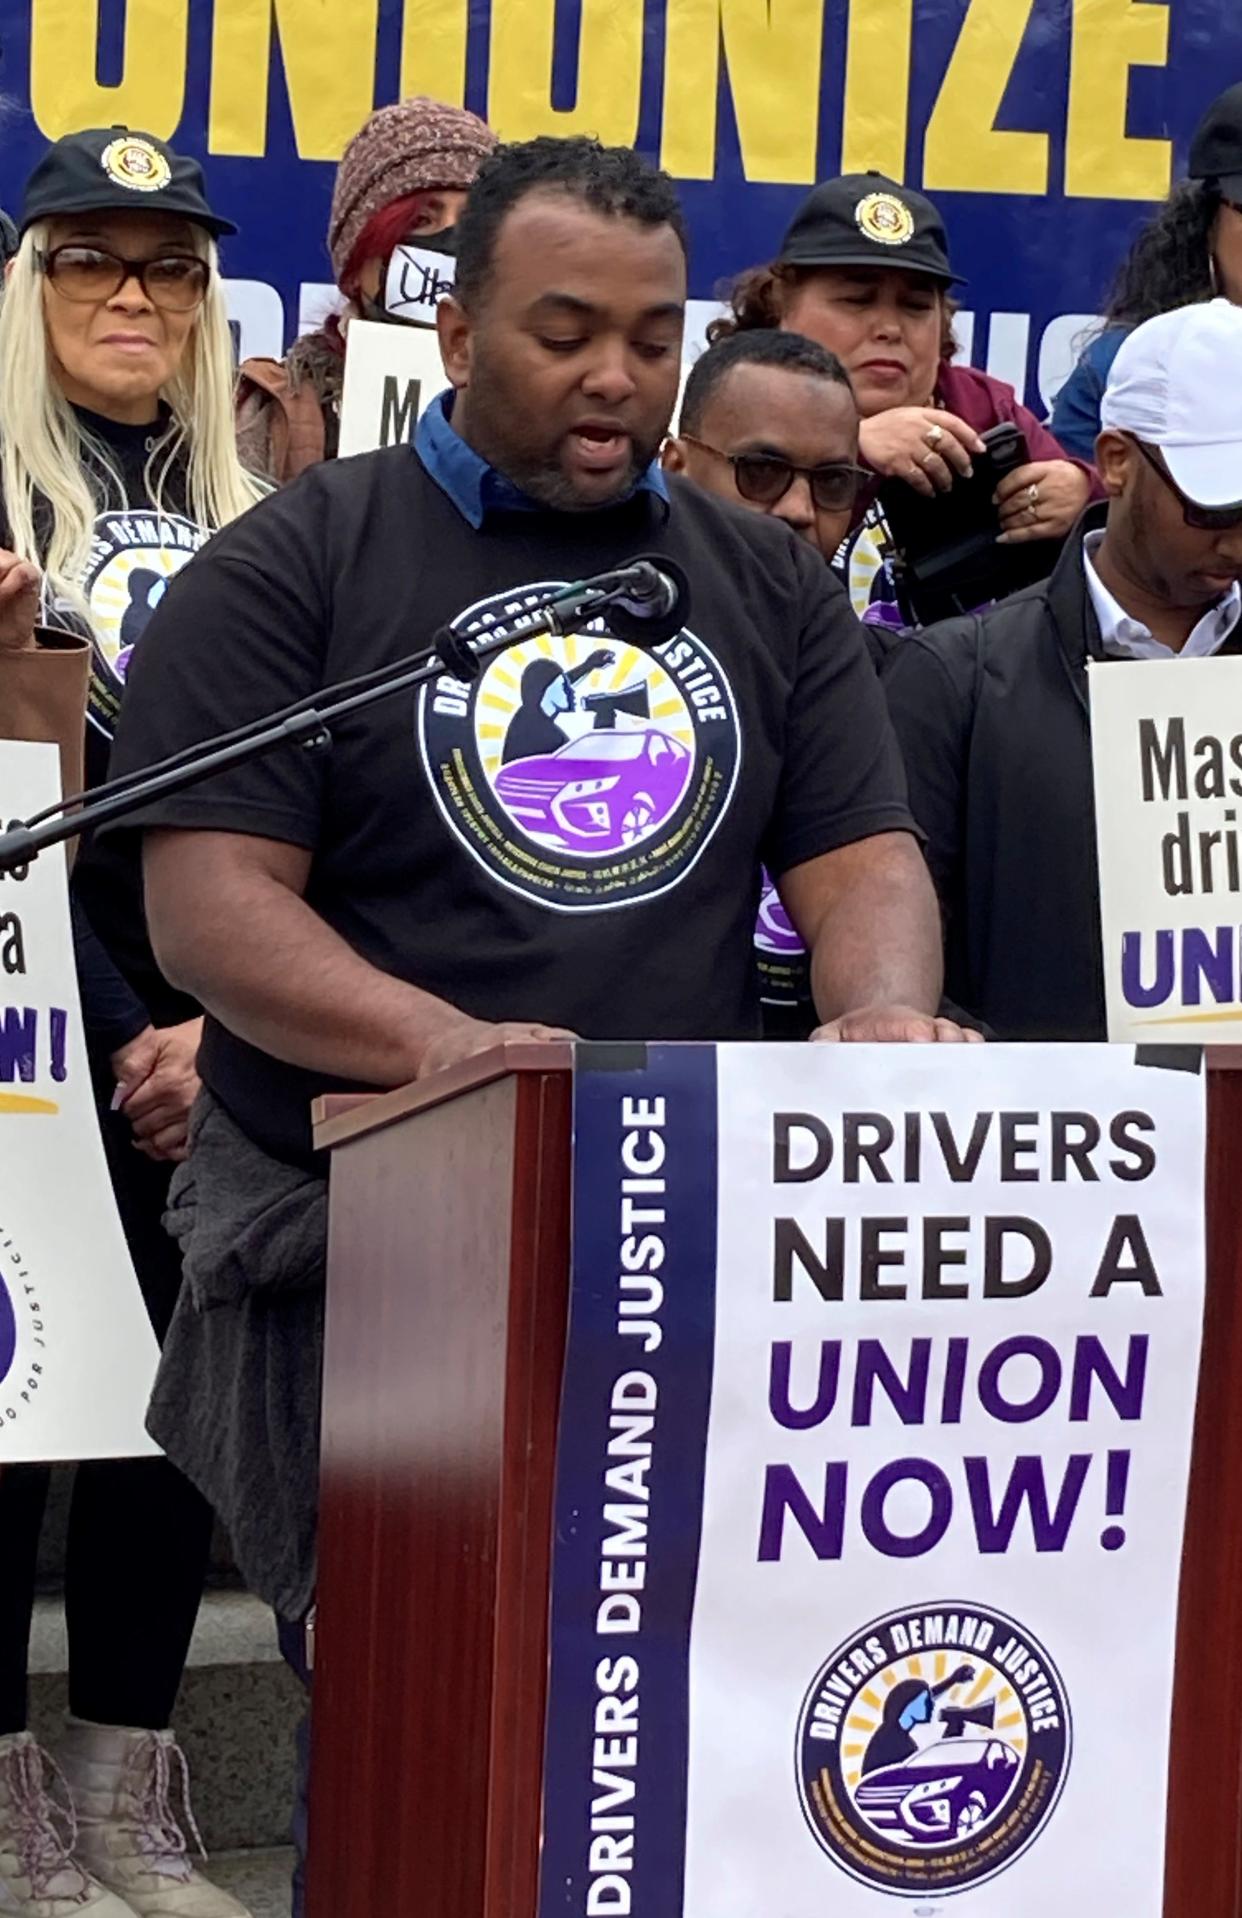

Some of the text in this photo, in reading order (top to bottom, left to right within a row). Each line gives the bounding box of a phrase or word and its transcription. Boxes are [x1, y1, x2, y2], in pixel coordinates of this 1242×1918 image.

[652, 634, 728, 723] STICE
[1121, 926, 1242, 1008] UN
[773, 1110, 1157, 1184] DRIVERS
[772, 1213, 1164, 1302] NEED A
[768, 1333, 1150, 1431] UNION
[586, 1096, 666, 1917] DRIVERS DEMAND JUSTICE
[757, 1448, 1132, 1562] NOW!
[809, 1614, 1060, 1741] DRIVERS DEMAND JUSTICE
